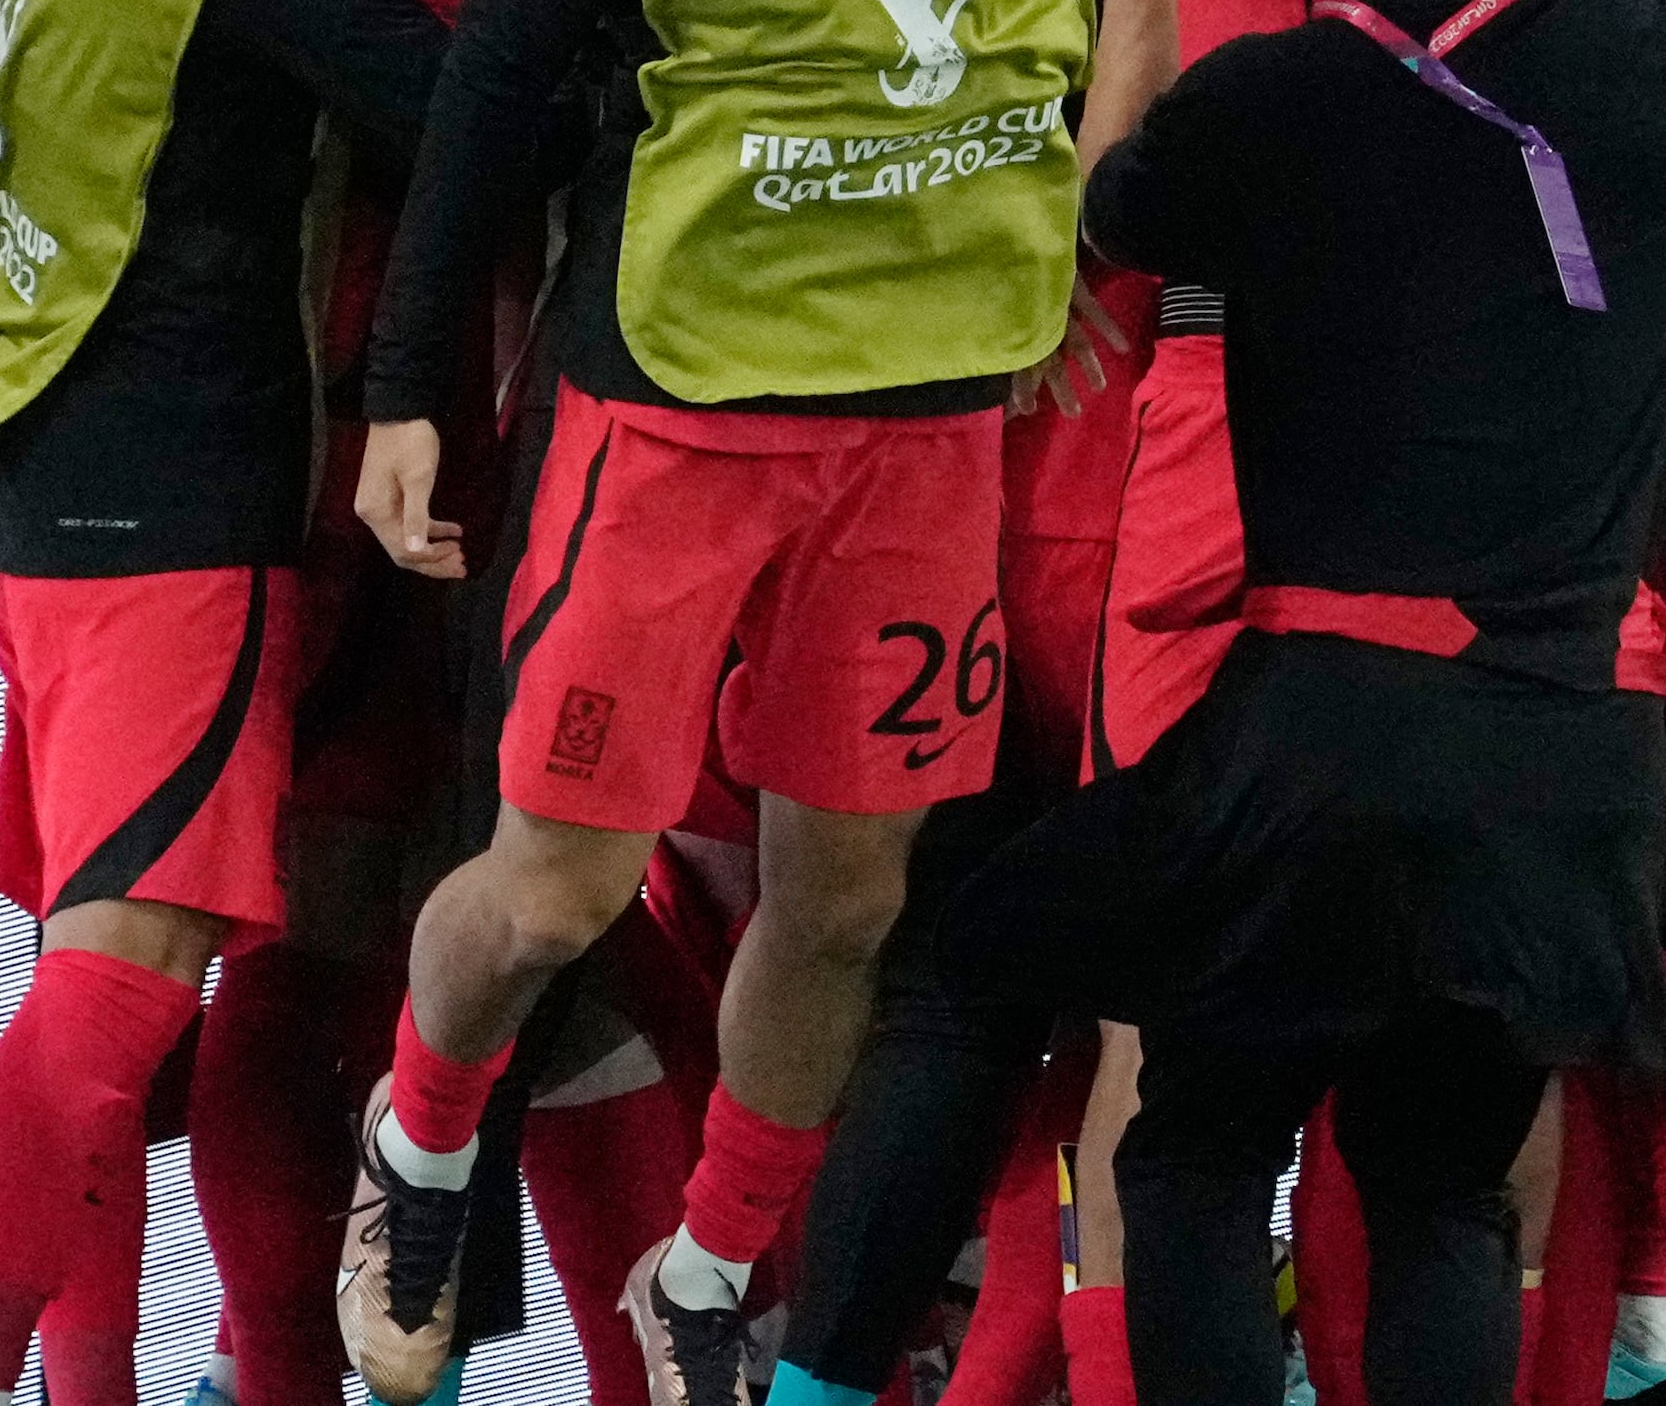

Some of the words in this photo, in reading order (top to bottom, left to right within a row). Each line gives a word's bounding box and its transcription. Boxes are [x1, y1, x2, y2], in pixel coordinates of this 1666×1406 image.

[739, 132, 834, 171] FIFA
[843, 114, 991, 164] WORLD
[867, 597, 1002, 736] 26
